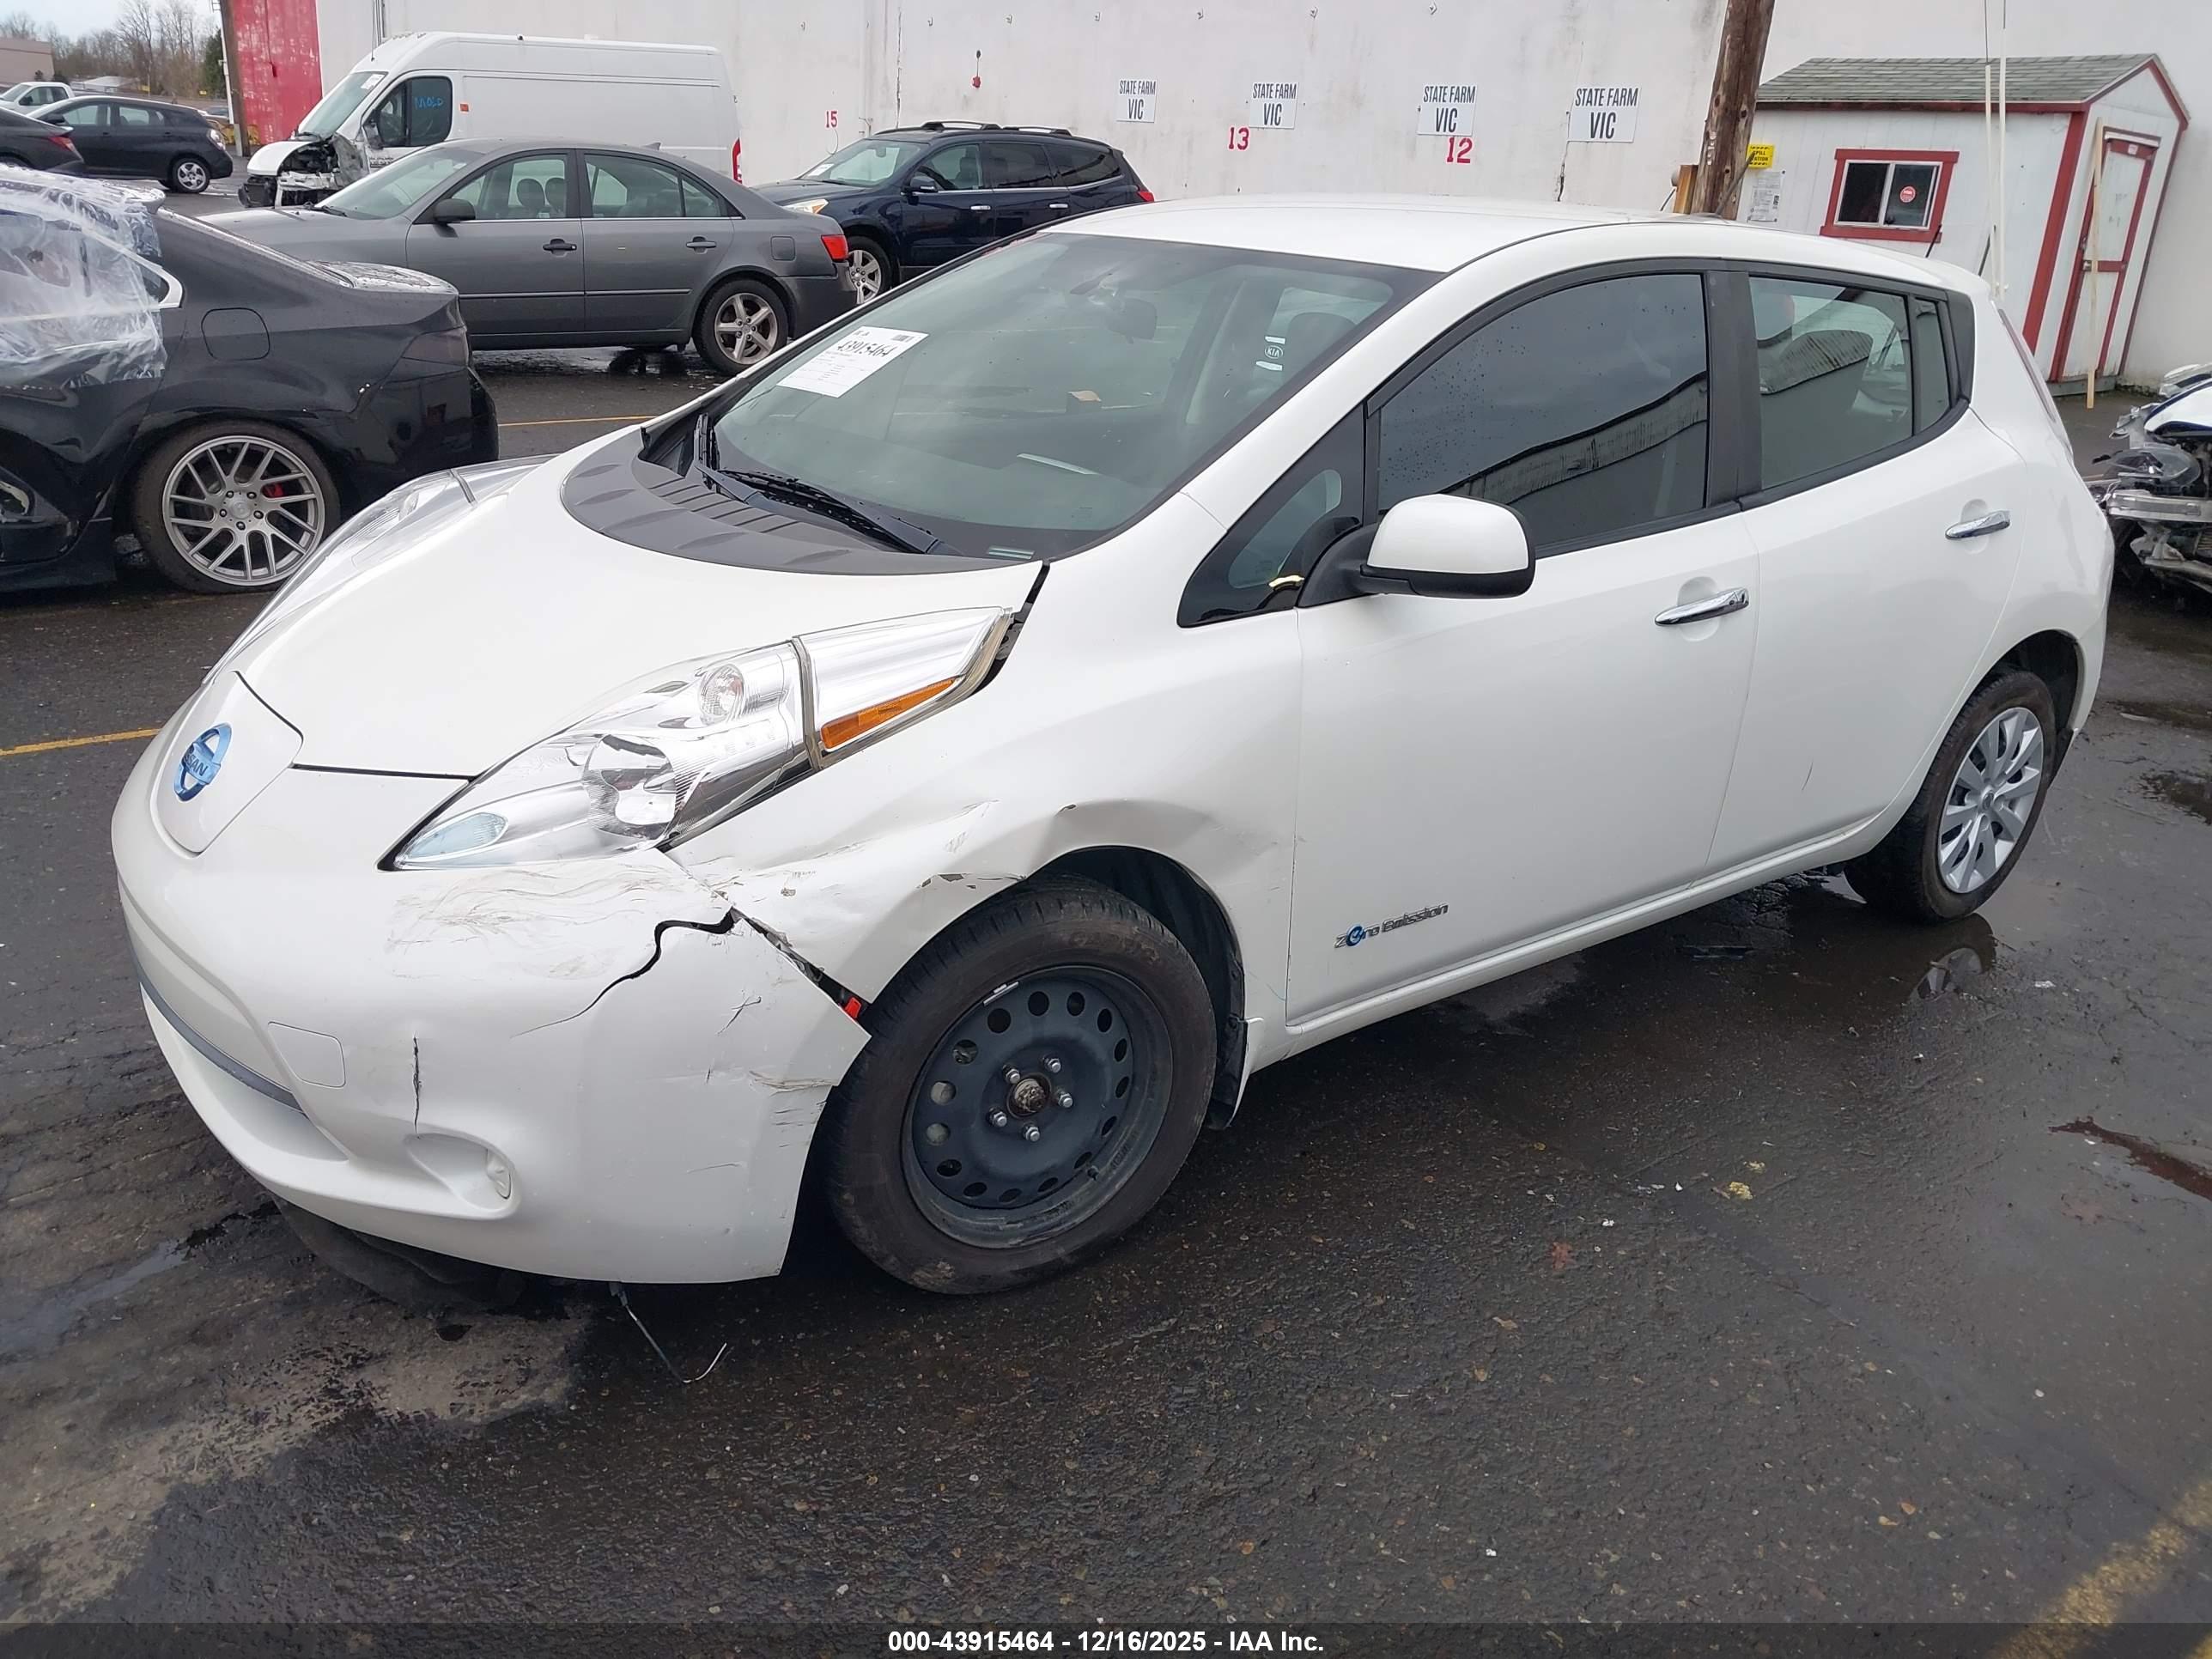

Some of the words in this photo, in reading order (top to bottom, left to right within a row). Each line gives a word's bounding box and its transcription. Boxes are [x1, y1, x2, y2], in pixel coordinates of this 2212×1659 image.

[1119, 80, 1137, 94] STATE
[1137, 81, 1157, 95] FARM
[1253, 83, 1274, 99] STATE
[1274, 83, 1297, 99] FARM
[1423, 86, 1449, 103] STATE
[1449, 86, 1476, 104] FARM
[1575, 88, 1606, 106] STATE
[1607, 88, 1639, 106] FARM
[826, 111, 838, 128] 15
[1128, 99, 1145, 120] VIC
[1263, 103, 1282, 125] VIC
[1435, 107, 1459, 133] VIC
[1589, 112, 1617, 139] VIC
[1228, 127, 1250, 150] 13
[1446, 137, 1474, 164] 12
